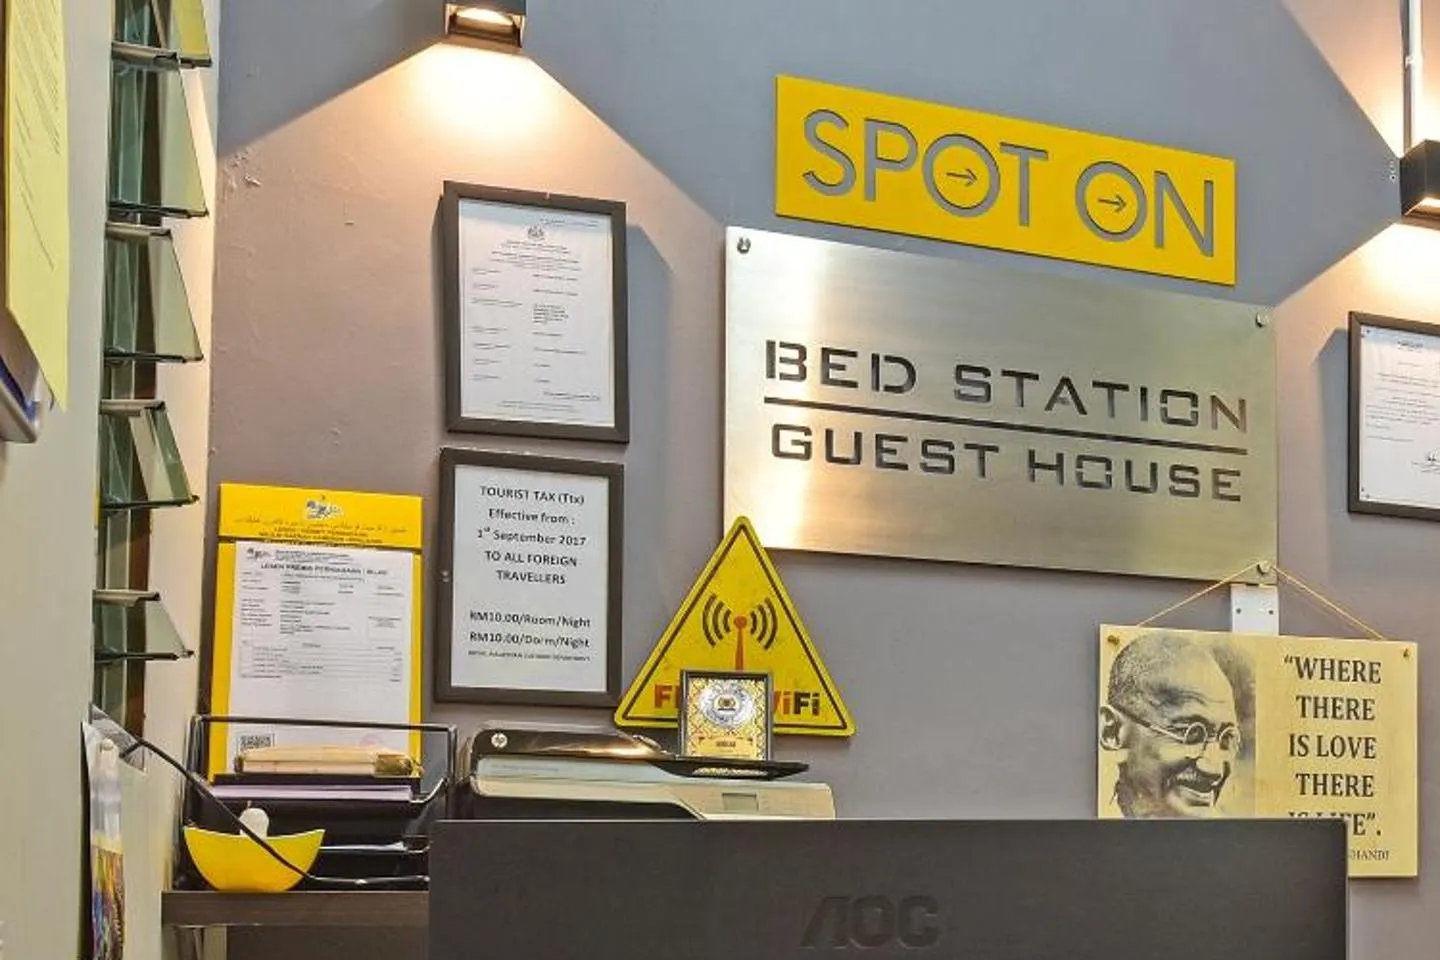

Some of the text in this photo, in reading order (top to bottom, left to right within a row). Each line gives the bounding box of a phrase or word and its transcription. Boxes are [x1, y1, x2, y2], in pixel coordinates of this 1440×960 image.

[803, 109, 1214, 258] SPOT ON
[765, 340, 1247, 433] BED STATION
[771, 424, 1241, 502] GUEST HOUSE
[480, 486, 529, 499] TOURIST
[534, 491, 556, 502] TAX
[488, 508, 538, 521] Effective
[541, 513, 569, 524] from
[493, 529, 556, 544] September
[559, 535, 586, 546] 2017
[484, 551, 578, 566] TO ALL FOREIGN
[496, 570, 566, 584] TRAVELLERS
[1296, 696, 1375, 721] THERE
[1289, 734, 1376, 759] IS LOVE
[1296, 773, 1374, 798] THERE
[798, 895, 940, 949] AOC
